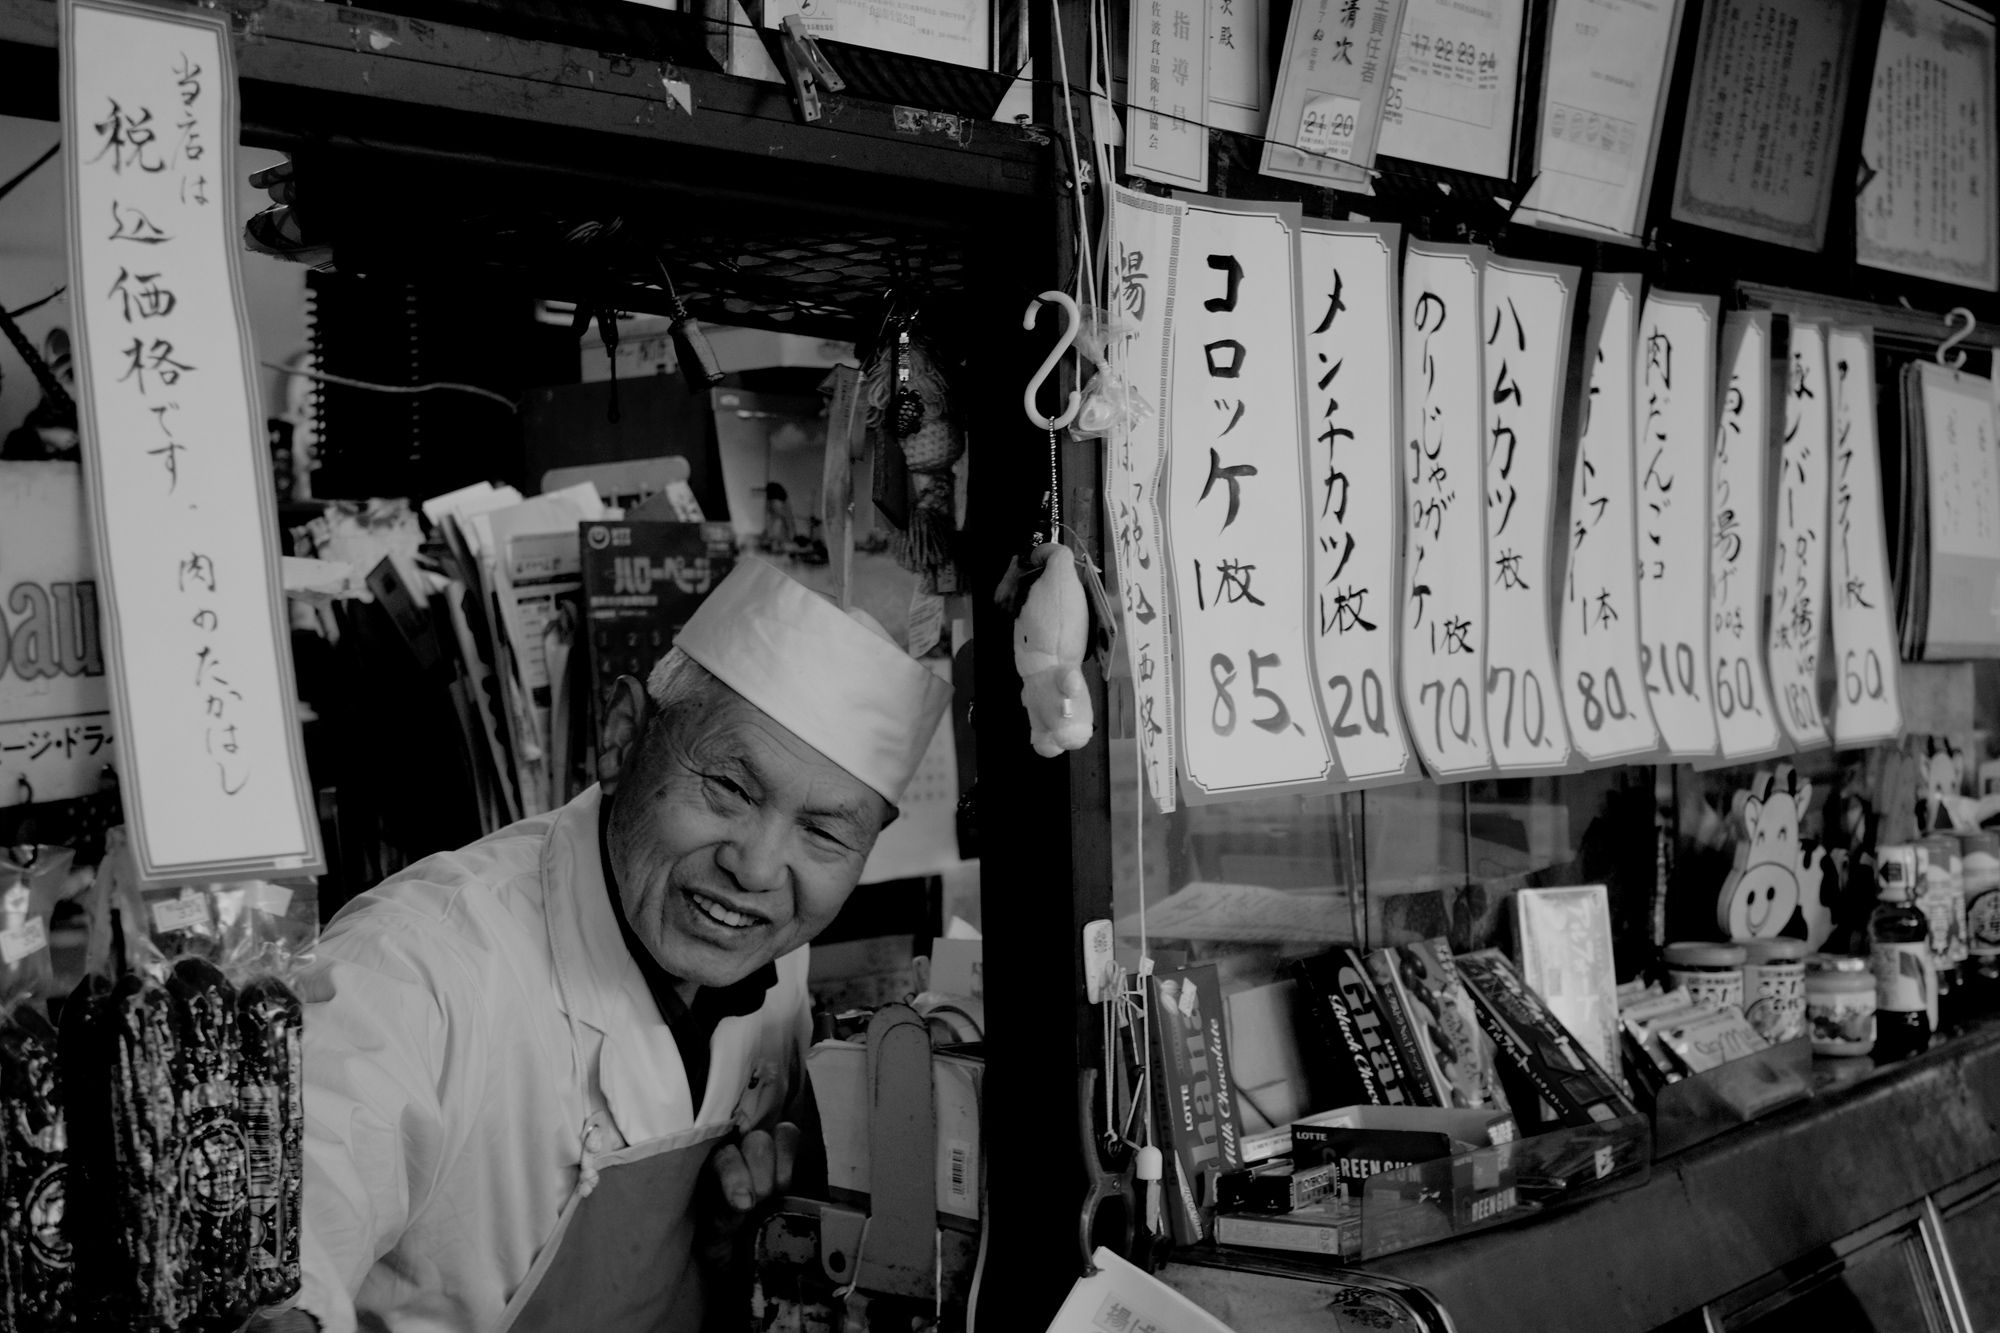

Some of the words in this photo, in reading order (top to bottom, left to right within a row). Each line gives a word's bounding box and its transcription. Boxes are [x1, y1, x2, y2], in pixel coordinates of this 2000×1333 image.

[171, 50, 209, 206] 当店は
[1171, 9, 1191, 135] 指導員
[1195, 253, 1259, 538] コロッケ
[1308, 267, 1356, 584] メンチカツ
[1486, 295, 1526, 538] ハムカツ
[0, 580, 104, 681] au
[178, 551, 252, 797] 肉のたかはし
[1181, 989, 1222, 1171] hana
[1209, 1017, 1231, 1119] Chocolate
[1328, 994, 1363, 1053] Black
[1384, 1038, 1405, 1080] LOTTE
[1179, 1084, 1195, 1132] LOTTE
[1220, 1121, 1239, 1169] Milk
[1295, 1131, 1328, 1142] LOTTE
